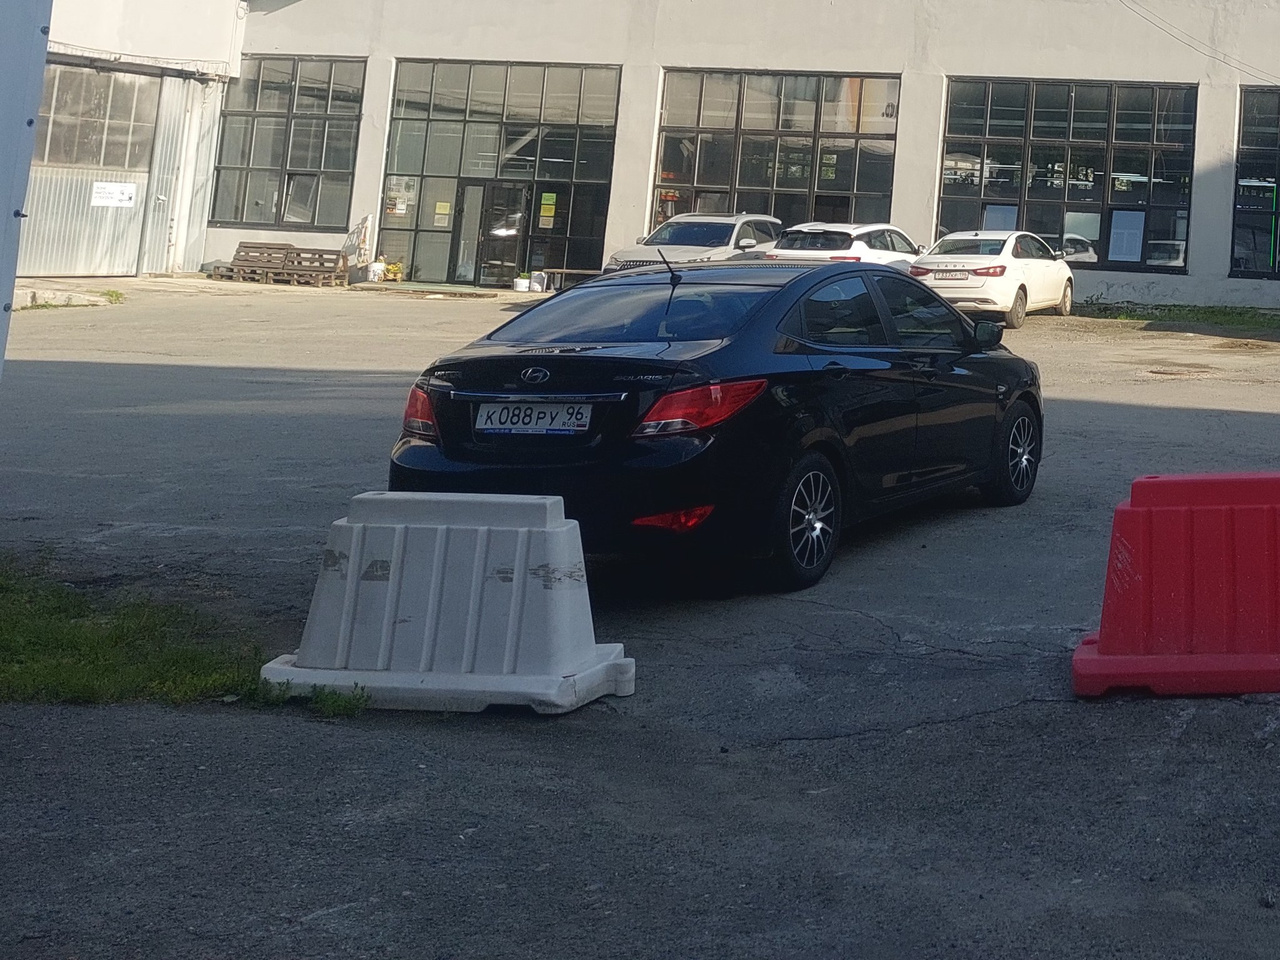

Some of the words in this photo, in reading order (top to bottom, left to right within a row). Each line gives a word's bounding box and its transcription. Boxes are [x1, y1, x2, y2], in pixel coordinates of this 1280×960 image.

[484, 405, 559, 426] К088РУ
[566, 405, 584, 420] 96
[561, 420, 576, 428] RUS
